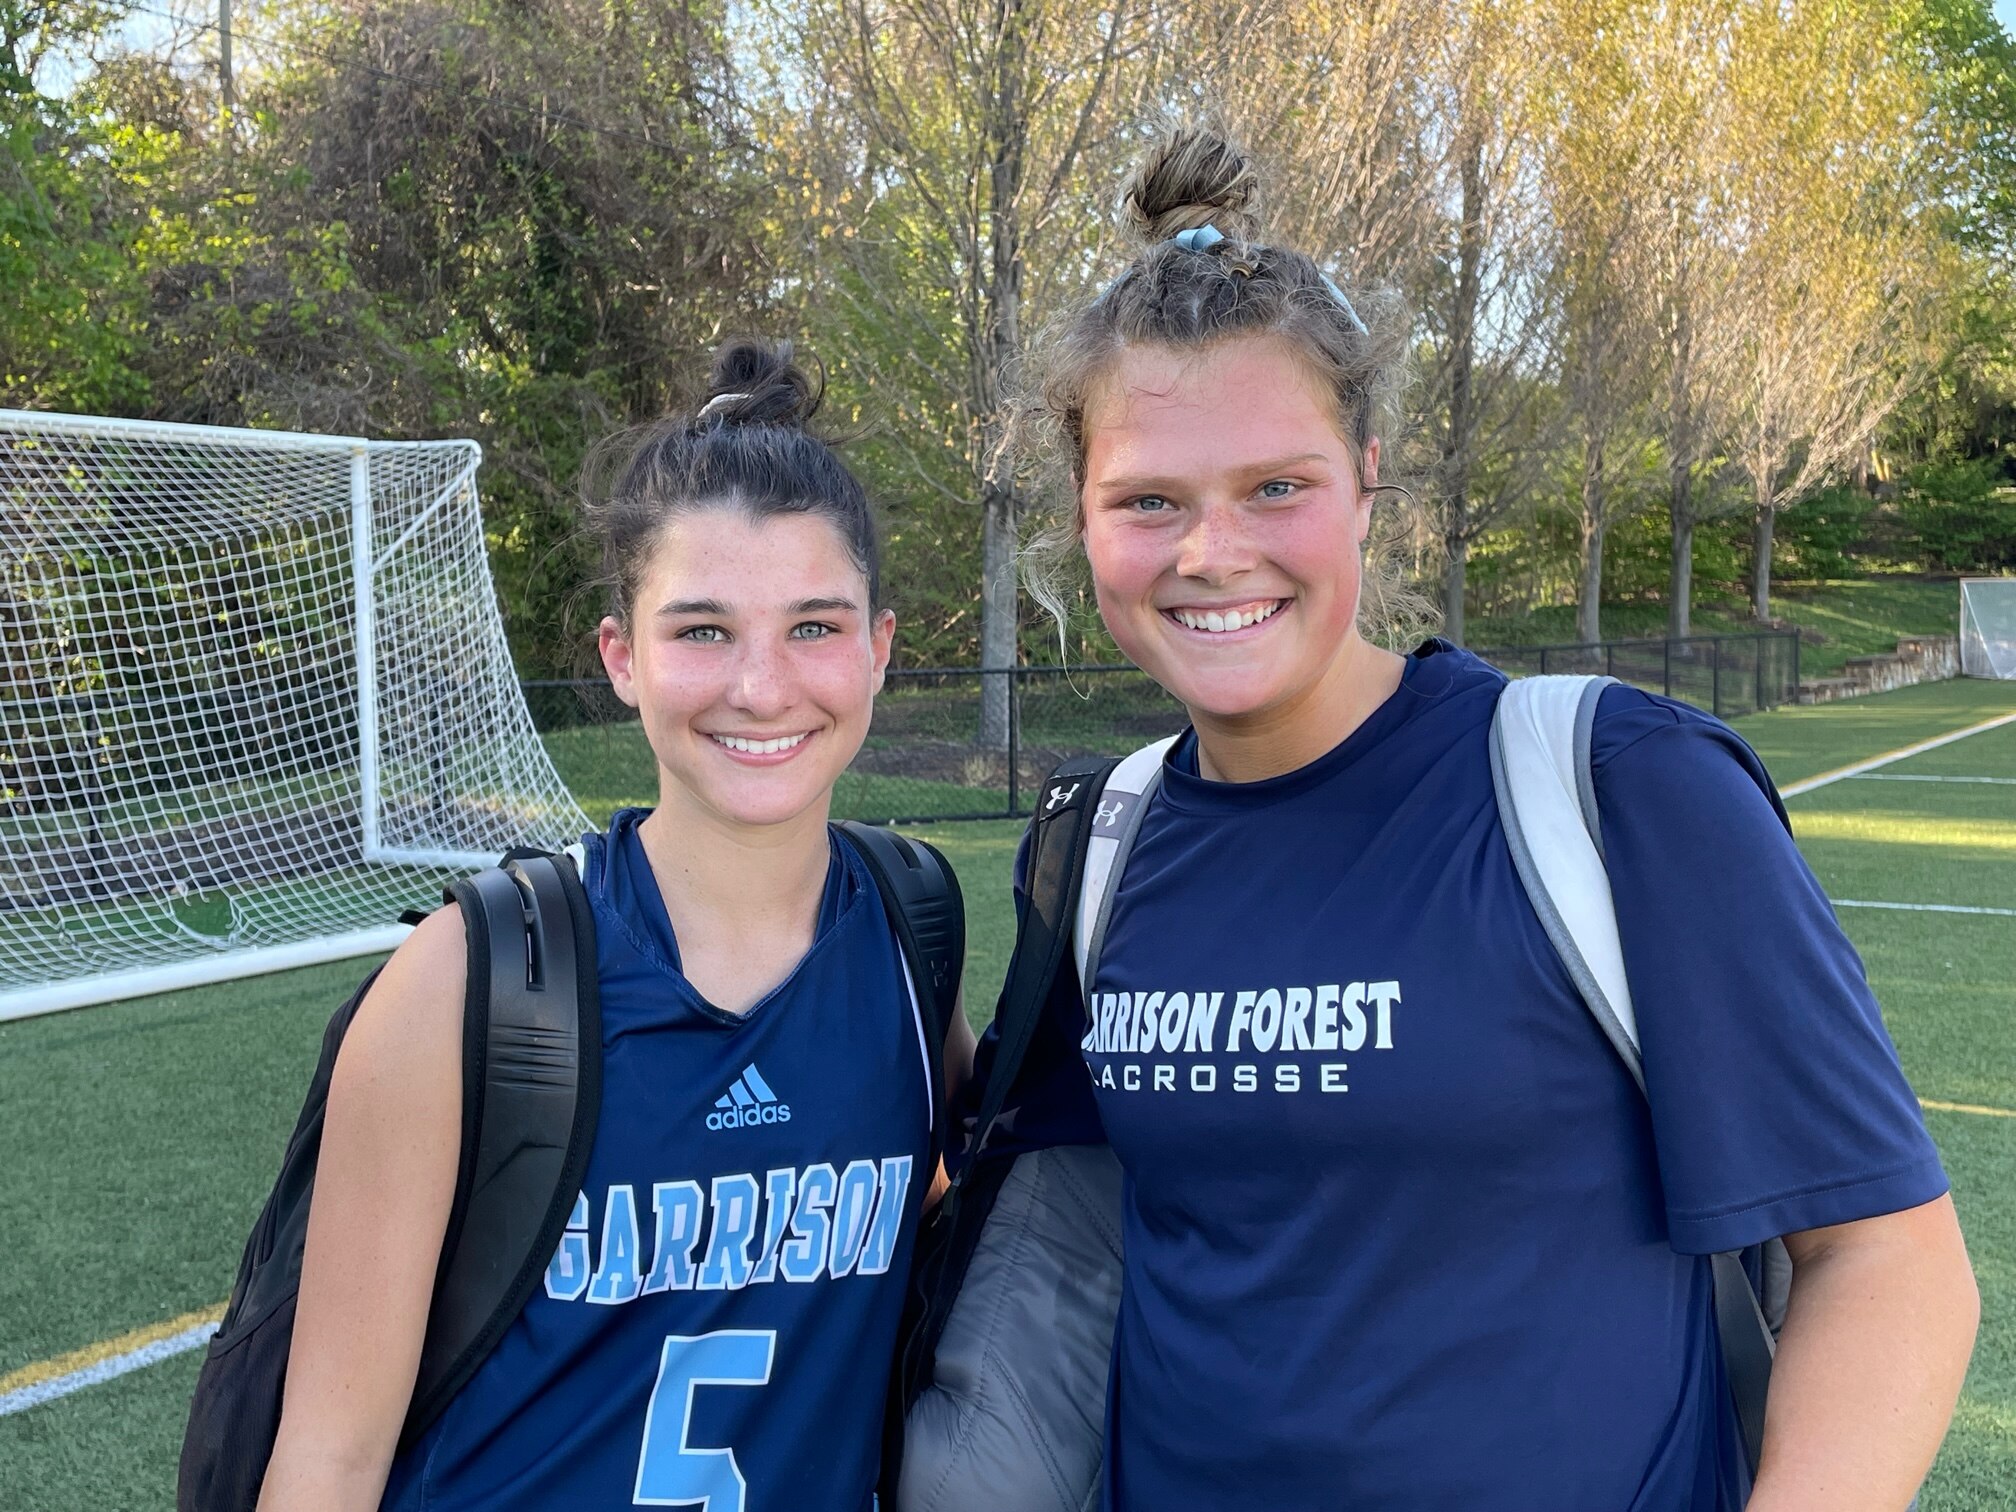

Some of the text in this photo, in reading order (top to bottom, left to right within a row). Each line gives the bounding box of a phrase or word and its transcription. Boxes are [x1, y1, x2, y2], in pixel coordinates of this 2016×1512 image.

[1080, 980, 1402, 1054] ARRISON FOREST
[705, 1102, 791, 1131] adidas
[543, 1154, 913, 1305] GARRISON
[632, 1329, 777, 1512] 5
